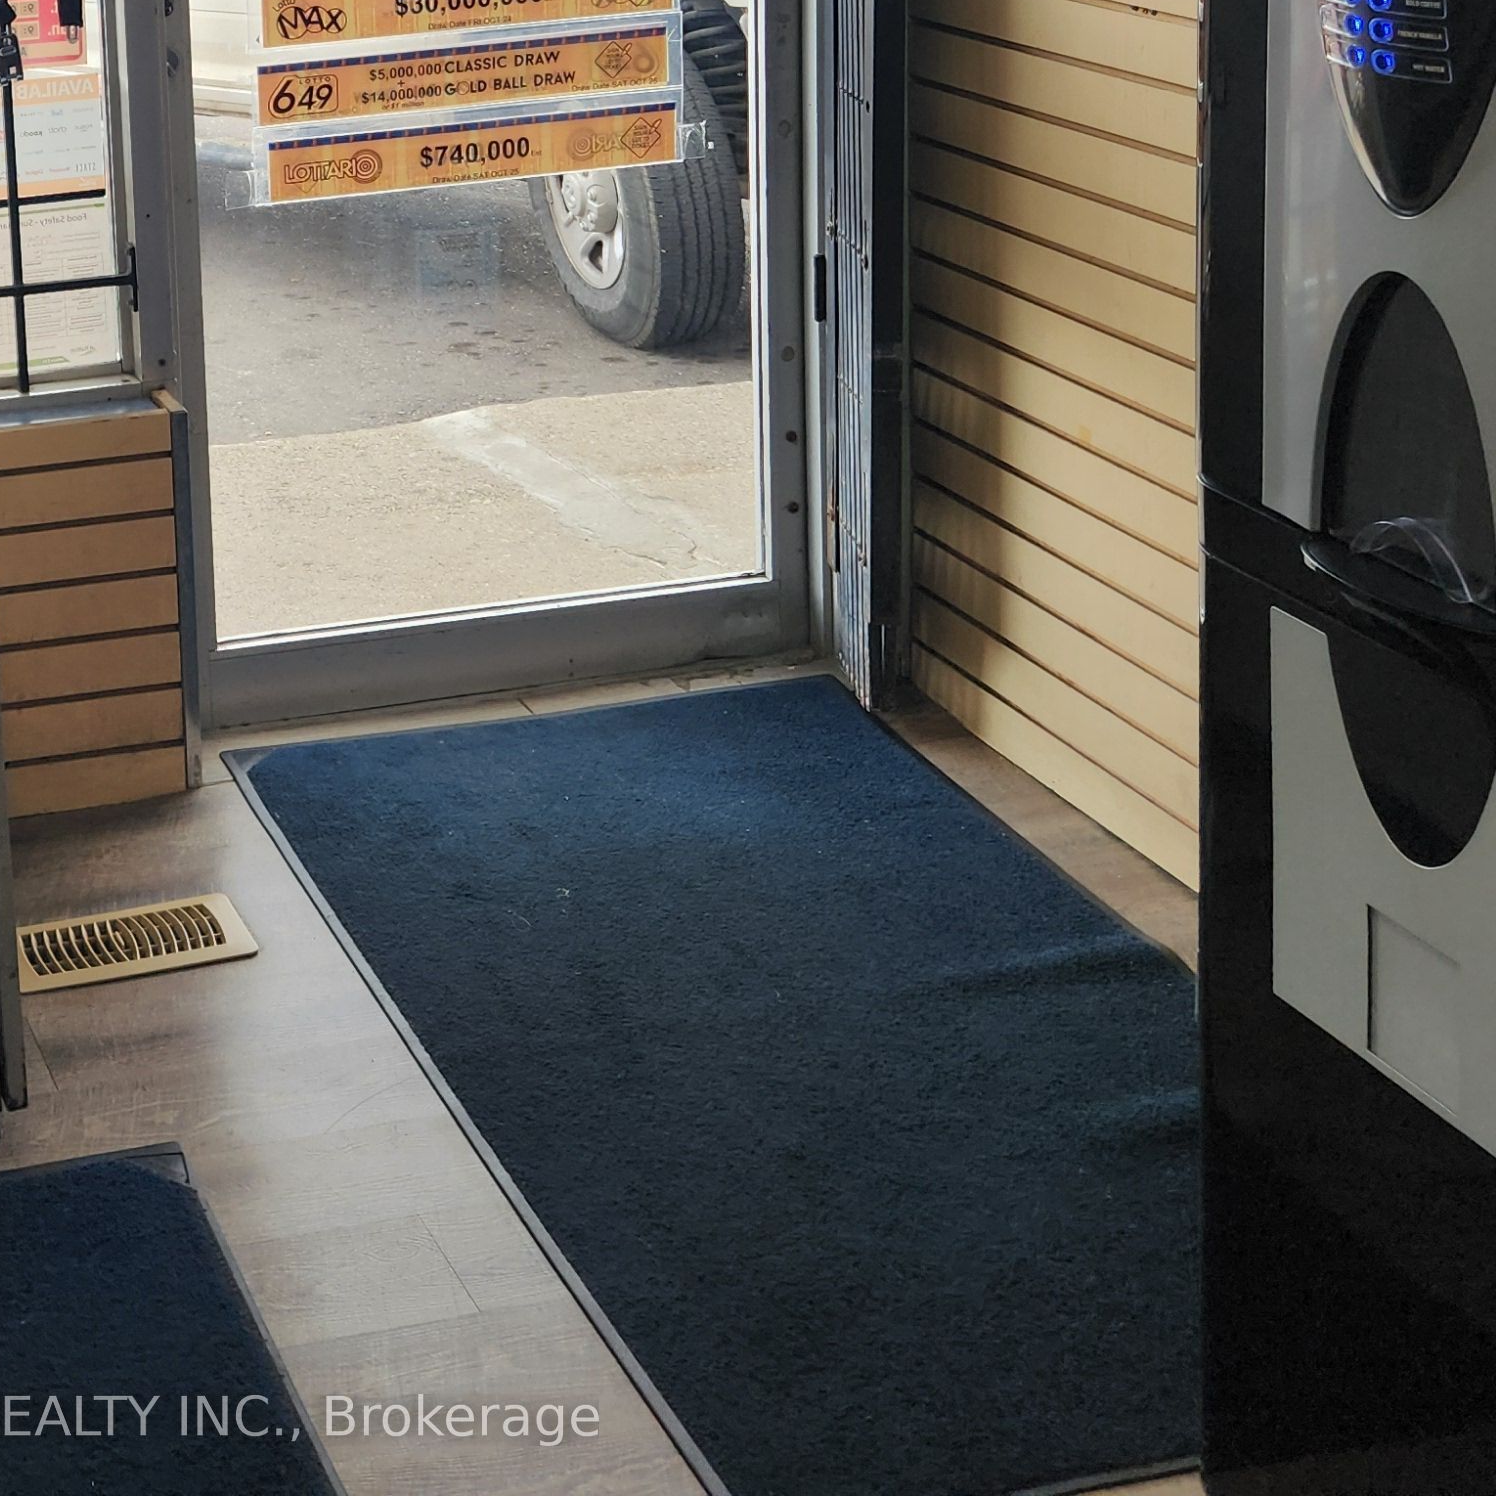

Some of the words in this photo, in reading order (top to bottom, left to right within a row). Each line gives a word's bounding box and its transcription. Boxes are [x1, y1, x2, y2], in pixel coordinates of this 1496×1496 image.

[276, 6, 347, 40] MAX
[298, 76, 331, 85] LOTTO
[369, 62, 442, 82] $5,000,000
[444, 54, 508, 75] CLASSIC
[513, 51, 561, 68] DRAW
[272, 79, 333, 115] 649
[361, 85, 442, 104] $14,000,000
[444, 79, 487, 97] GOLD
[493, 76, 527, 91] BALL
[533, 71, 576, 87] DRAW
[283, 149, 383, 185] LOTTARIO
[419, 136, 530, 170] $740,000
